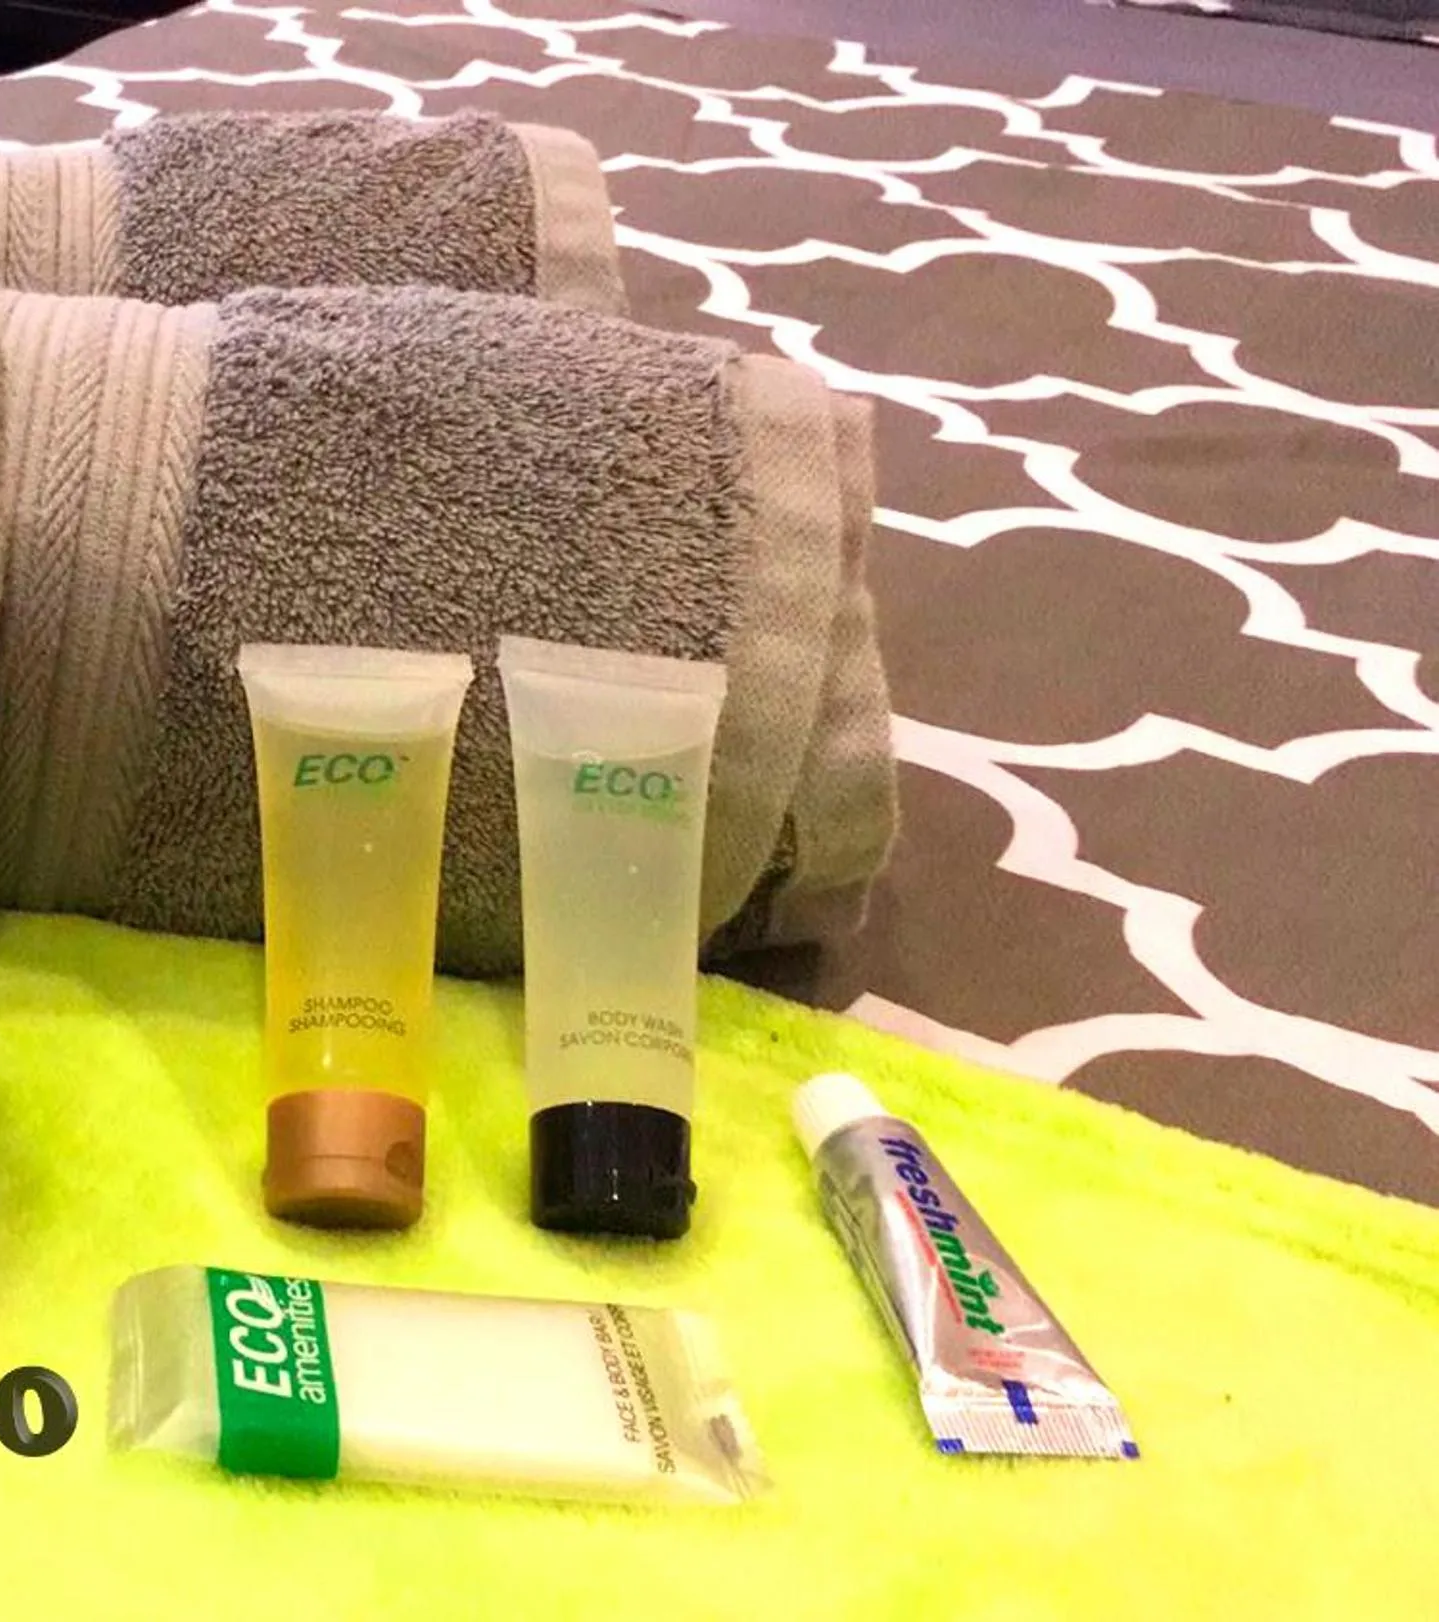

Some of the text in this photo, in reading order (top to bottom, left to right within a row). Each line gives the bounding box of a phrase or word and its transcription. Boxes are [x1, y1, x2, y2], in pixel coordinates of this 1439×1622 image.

[294, 755, 395, 787] ECO
[573, 764, 673, 801] ECO
[303, 997, 393, 1015] SHAMPOO
[588, 1011, 638, 1027] BODY
[560, 1030, 620, 1049] SAVON
[879, 1138, 1005, 1335] freshmint
[225, 1276, 293, 1397] ECO
[286, 1276, 327, 1404] amenities
[621, 1340, 642, 1359] ET
[600, 1346, 626, 1386] BODY
[627, 1360, 659, 1412] VISAGE
[616, 1401, 641, 1443] FACE
[648, 1416, 677, 1474] SAVON
